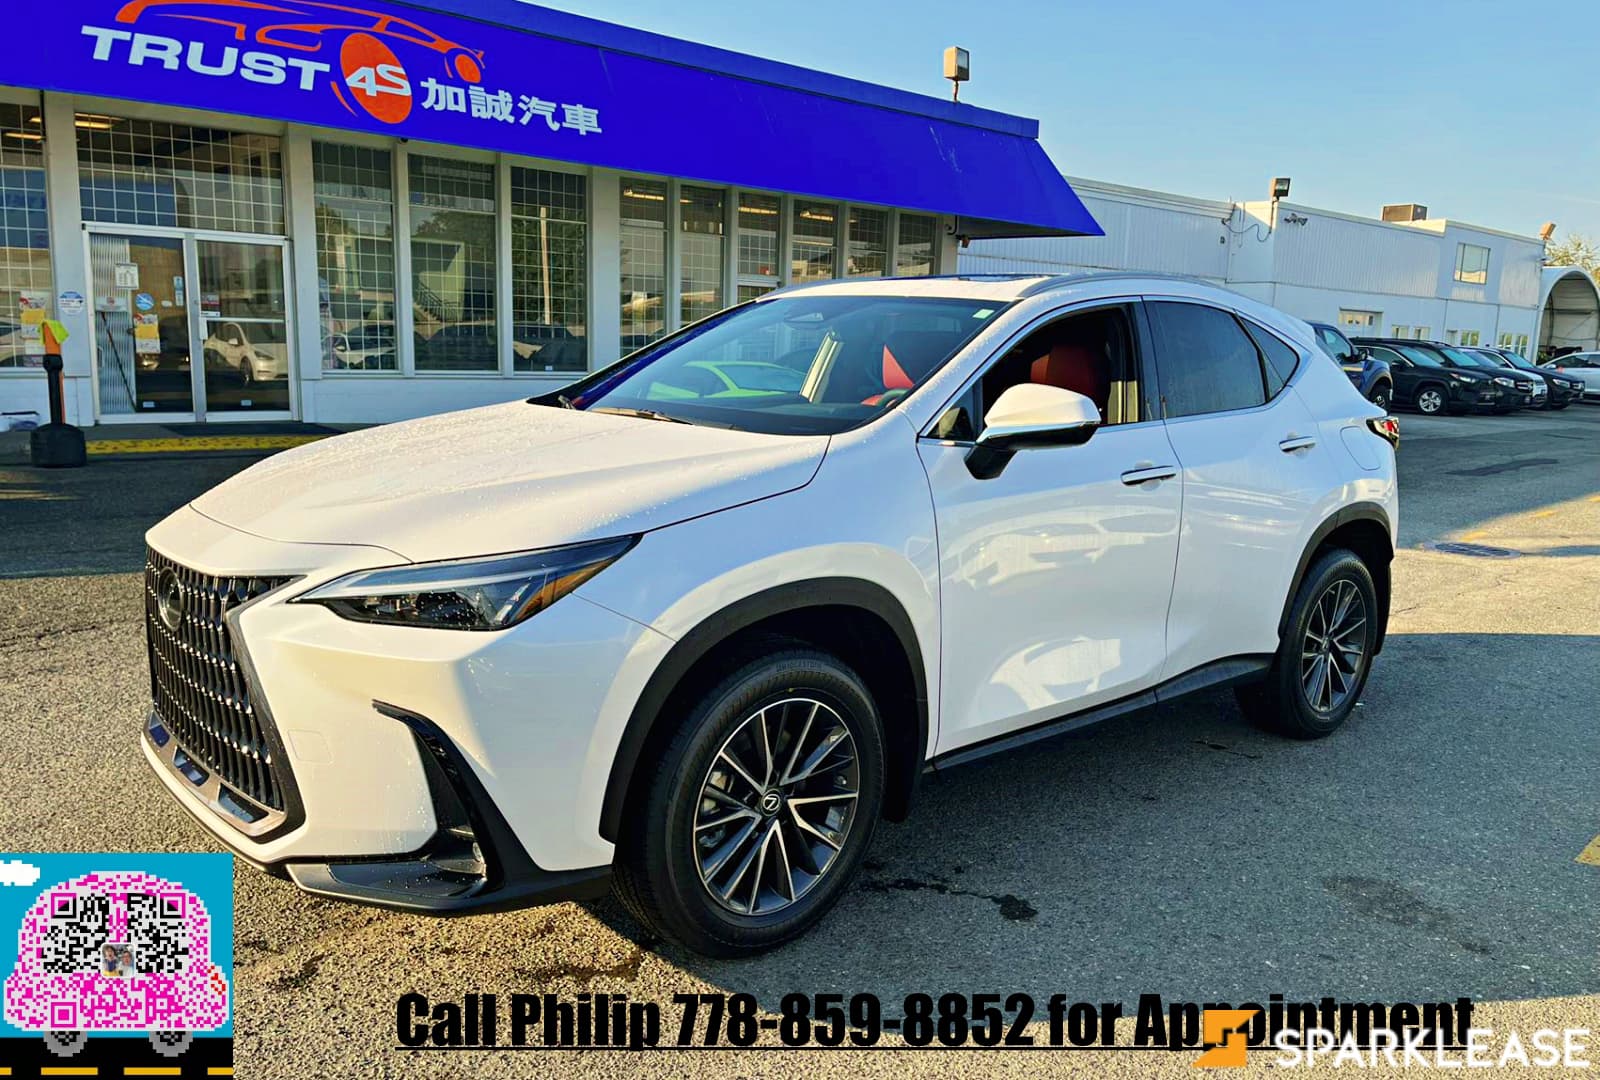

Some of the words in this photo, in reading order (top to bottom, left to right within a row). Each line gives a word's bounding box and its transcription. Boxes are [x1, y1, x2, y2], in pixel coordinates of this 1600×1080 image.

[81, 25, 330, 92] TRUST
[345, 63, 412, 97] 4S
[420, 77, 602, 135] 加誠汽車
